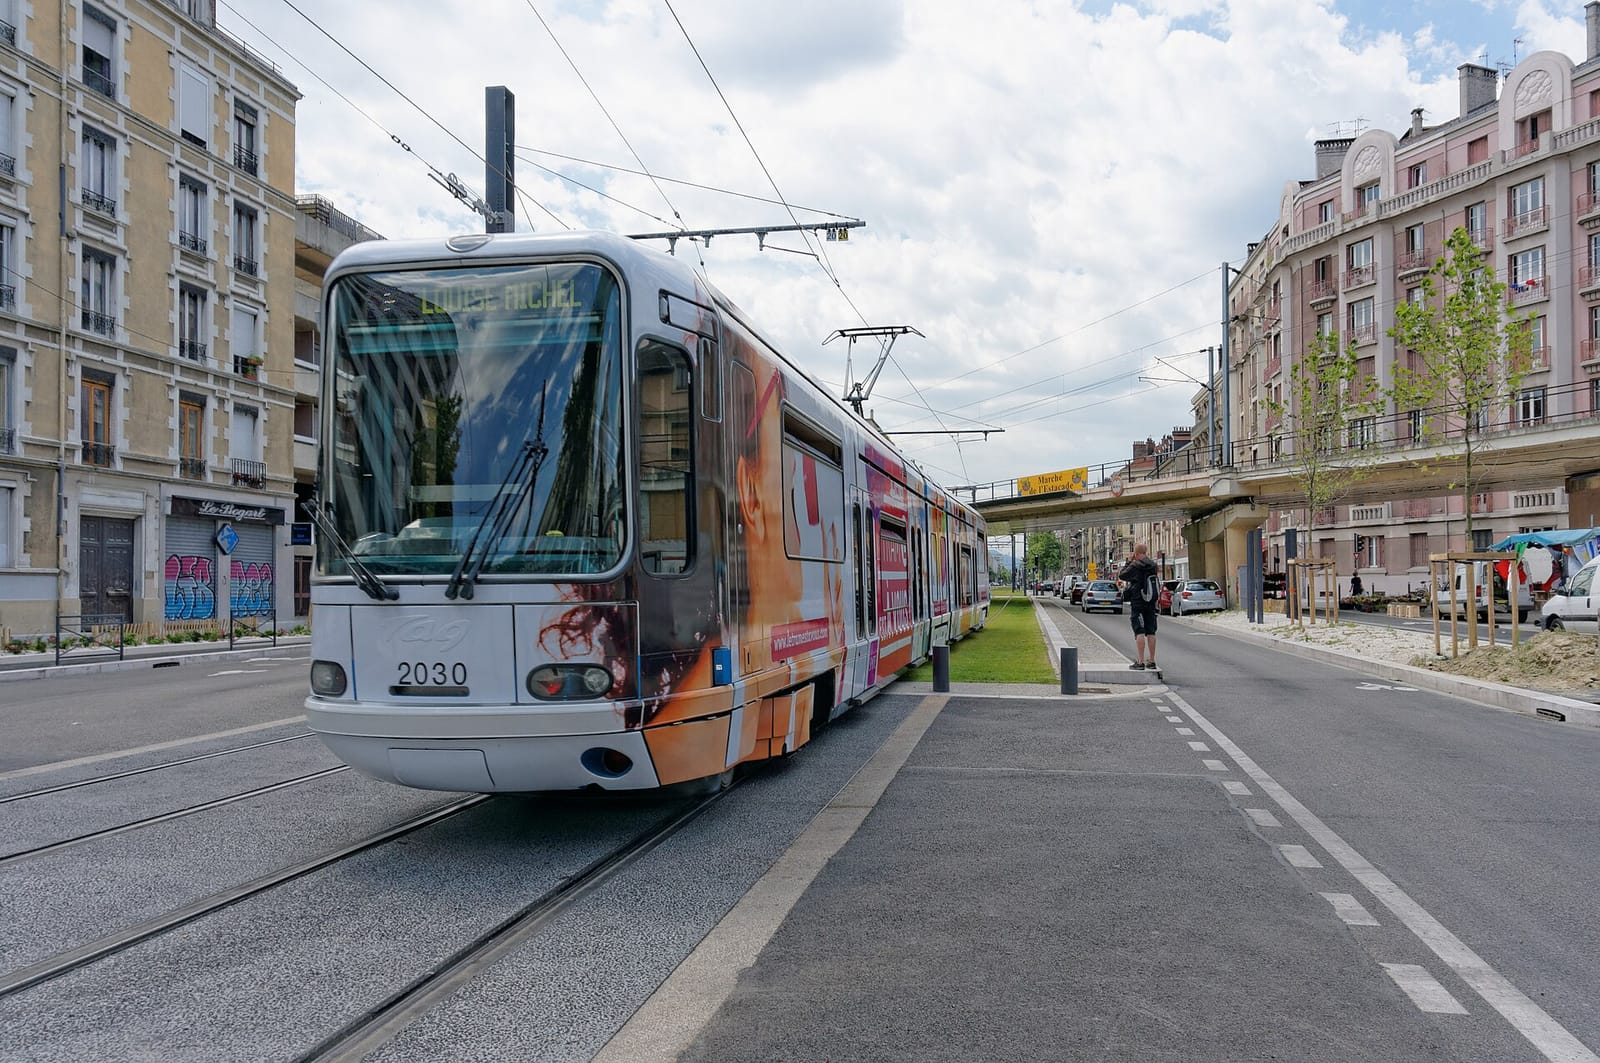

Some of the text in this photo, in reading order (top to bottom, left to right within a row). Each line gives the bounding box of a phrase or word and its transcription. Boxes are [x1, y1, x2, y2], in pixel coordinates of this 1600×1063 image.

[421, 279, 582, 314] LOUISE MICHEL
[1038, 482, 1074, 494] l'Estacade
[199, 501, 267, 521] Le Bogart
[397, 661, 468, 686] 2030
